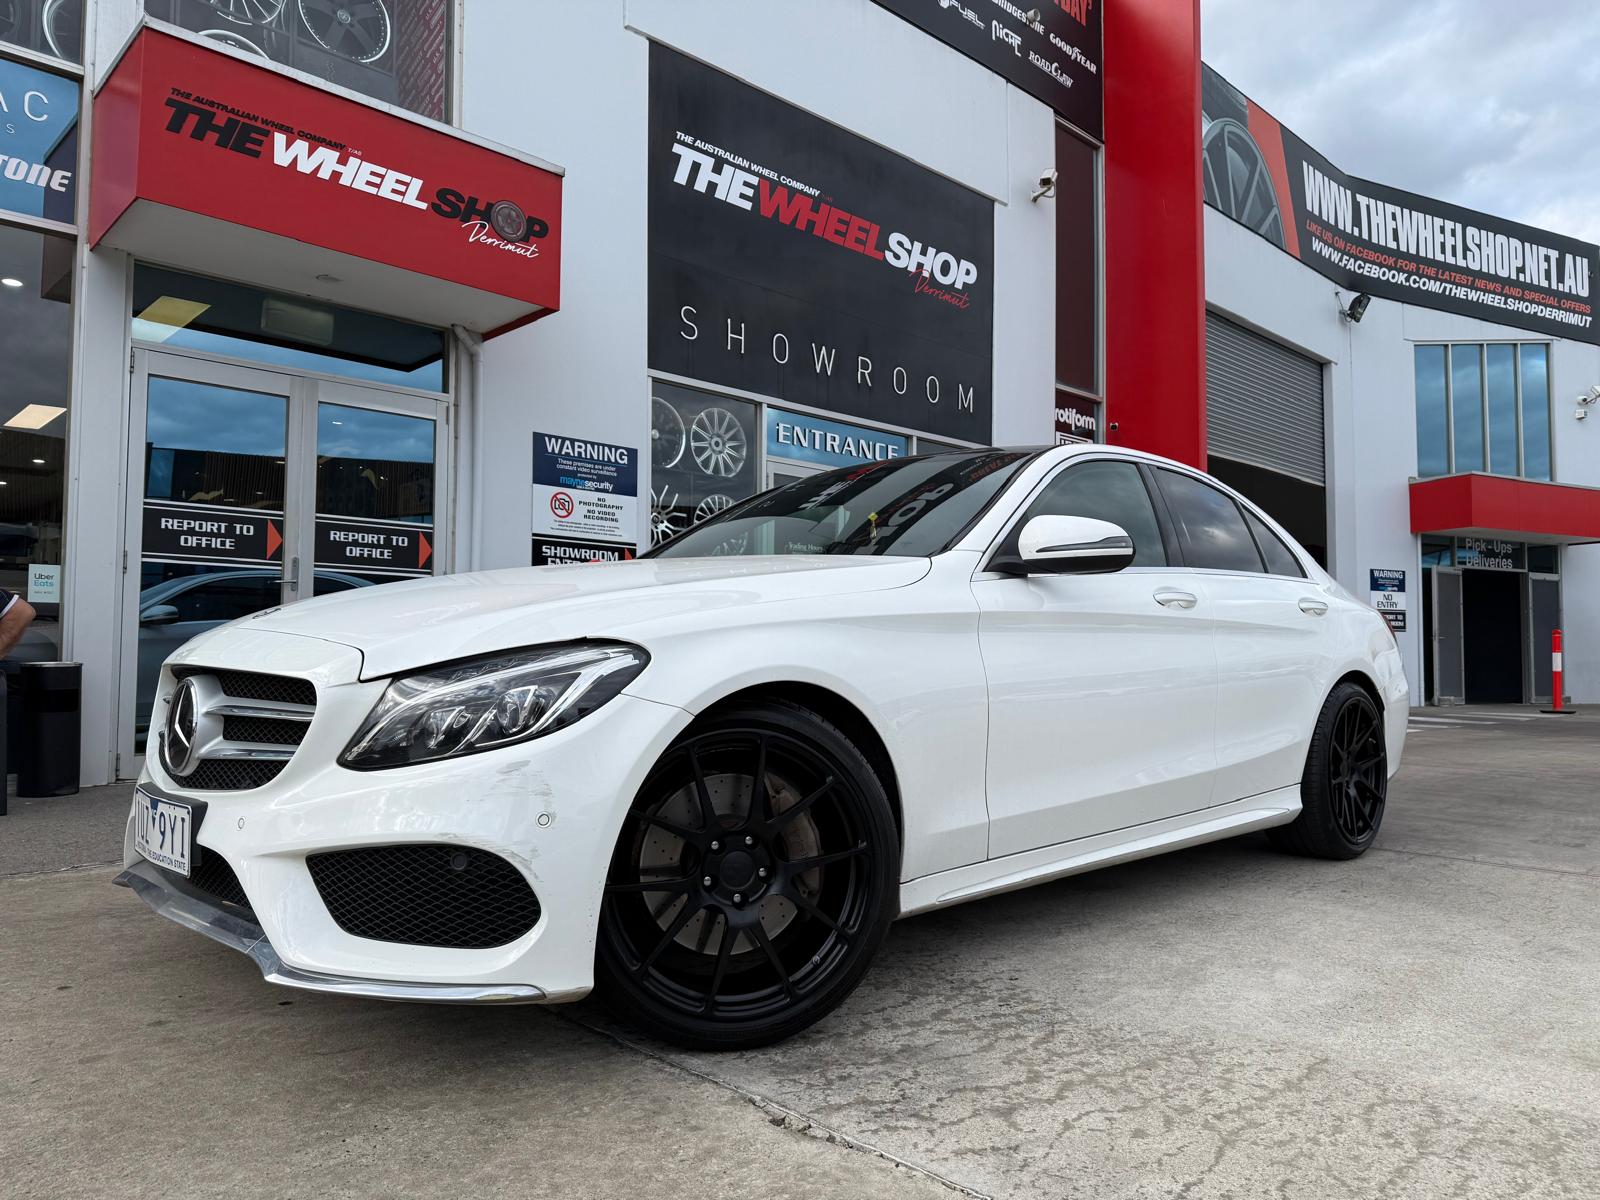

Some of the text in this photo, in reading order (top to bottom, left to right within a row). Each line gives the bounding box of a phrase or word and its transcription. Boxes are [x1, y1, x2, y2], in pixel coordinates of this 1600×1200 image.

[1050, 33, 1096, 74] GOODYEAR
[171, 87, 193, 99] THE
[192, 95, 259, 122] AUSTRALIAN
[261, 118, 295, 135] WHEEL
[297, 130, 346, 150] COMPANY
[165, 97, 549, 242] THE WHEEL SHOP
[676, 131, 821, 197] THE AUSTRALIAN WHEEL COMPANY
[671, 142, 977, 290] THE WHEEL SHOP
[1302, 160, 1590, 298] WWW.THEWHEELSHOP.NET.AU
[461, 221, 539, 258] Derrimut
[1306, 219, 1592, 314] LIKE US ON FACEBOOK FOR THE LATEST NEWS AND SPECIAL OFFERS
[909, 269, 970, 309] Derrimut
[1312, 236, 1592, 328] WWW.FACEBOOK.COM/THEWHEELSHOPDERRIMUT
[680, 305, 974, 413] SHOWROOM
[544, 436, 628, 464] WARNING
[777, 422, 898, 461] ENTRANCE
[578, 500, 623, 510] PHOTOGRAPHY
[584, 514, 619, 523] RECORDING
[160, 518, 254, 536] REPORT TO
[330, 530, 408, 547] REPORT TO
[180, 535, 235, 550] OFFICE
[346, 546, 392, 560] OFFICE
[542, 545, 619, 562] SHOWROOM
[1373, 569, 1403, 579] WARNING
[1466, 554, 1513, 569] Deliveries
[1377, 600, 1398, 608] ENTRY
[1383, 593, 1393, 601] NO
[174, 859, 186, 871] STATE
